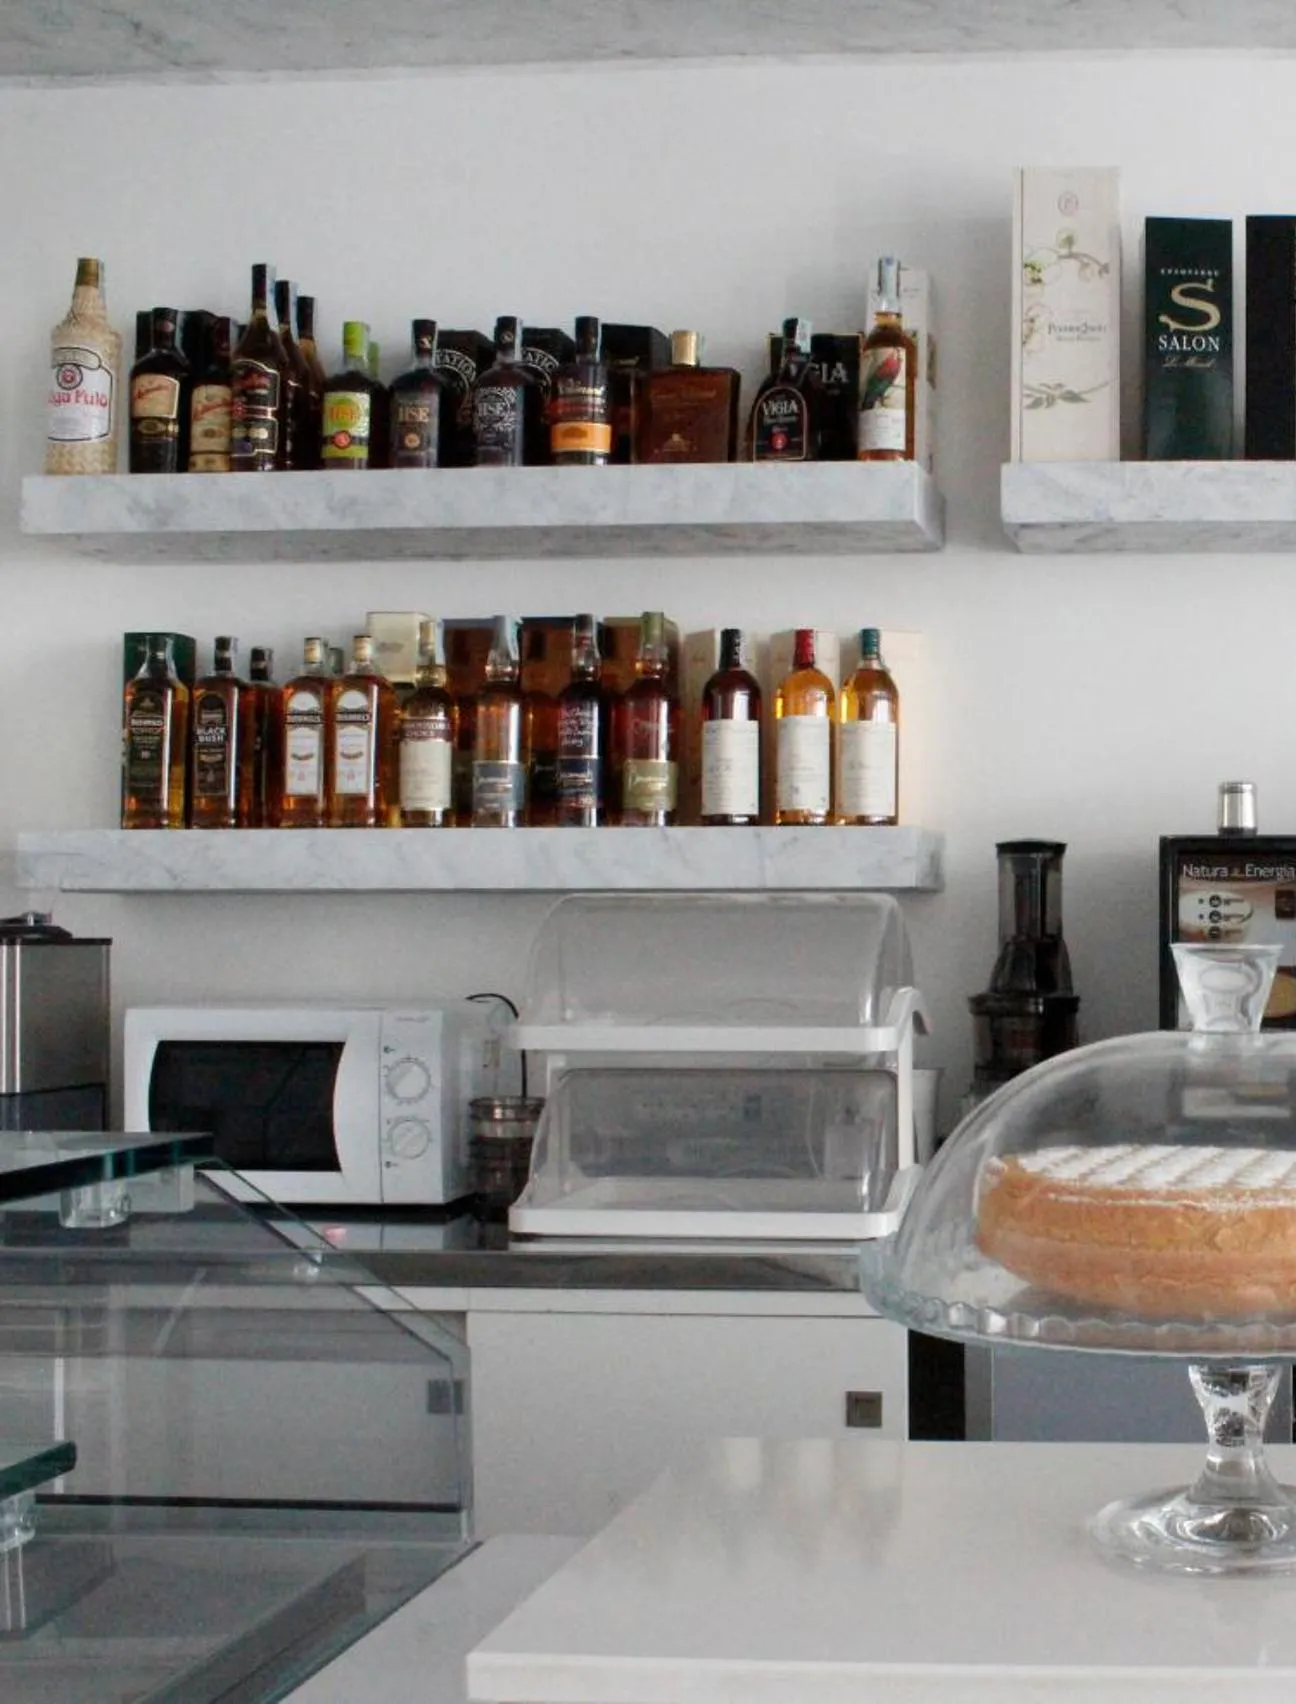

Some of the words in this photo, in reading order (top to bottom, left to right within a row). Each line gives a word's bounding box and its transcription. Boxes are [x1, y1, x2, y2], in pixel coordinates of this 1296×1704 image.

[1158, 278, 1221, 332] S
[1158, 334, 1220, 352] SALON
[398, 406, 430, 423] HSE
[196, 727, 227, 736] BLACK
[198, 735, 225, 743] BUSH
[1183, 863, 1229, 878] Natura
[1245, 863, 1296, 880] Energia
